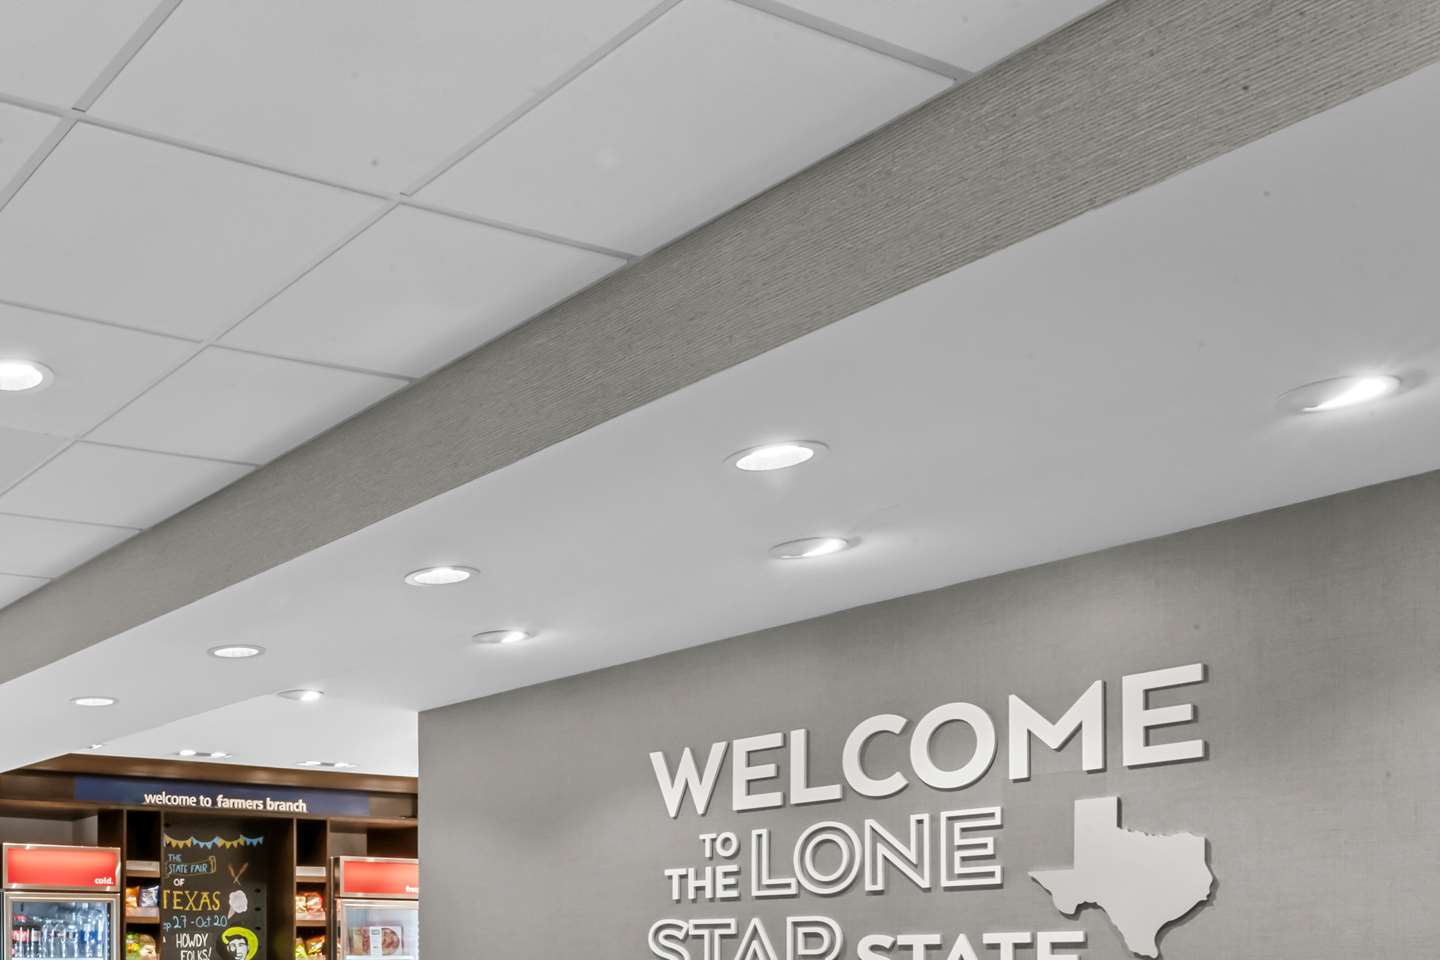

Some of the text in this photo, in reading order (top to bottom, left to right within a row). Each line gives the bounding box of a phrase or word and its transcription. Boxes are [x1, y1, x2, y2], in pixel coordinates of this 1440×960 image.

[649, 663, 1207, 818] WELCOME
[144, 792, 307, 812] welcome to farmers branch
[699, 832, 738, 859] TO
[751, 806, 1003, 897] LONE
[168, 854, 182, 862] THE
[168, 864, 208, 873] STATE FAIR
[173, 878, 185, 886] OF
[664, 865, 740, 900] THE
[162, 890, 221, 911] TEXAS
[173, 915, 187, 928] 27
[213, 915, 228, 927] 20
[176, 933, 209, 948] HOWDY
